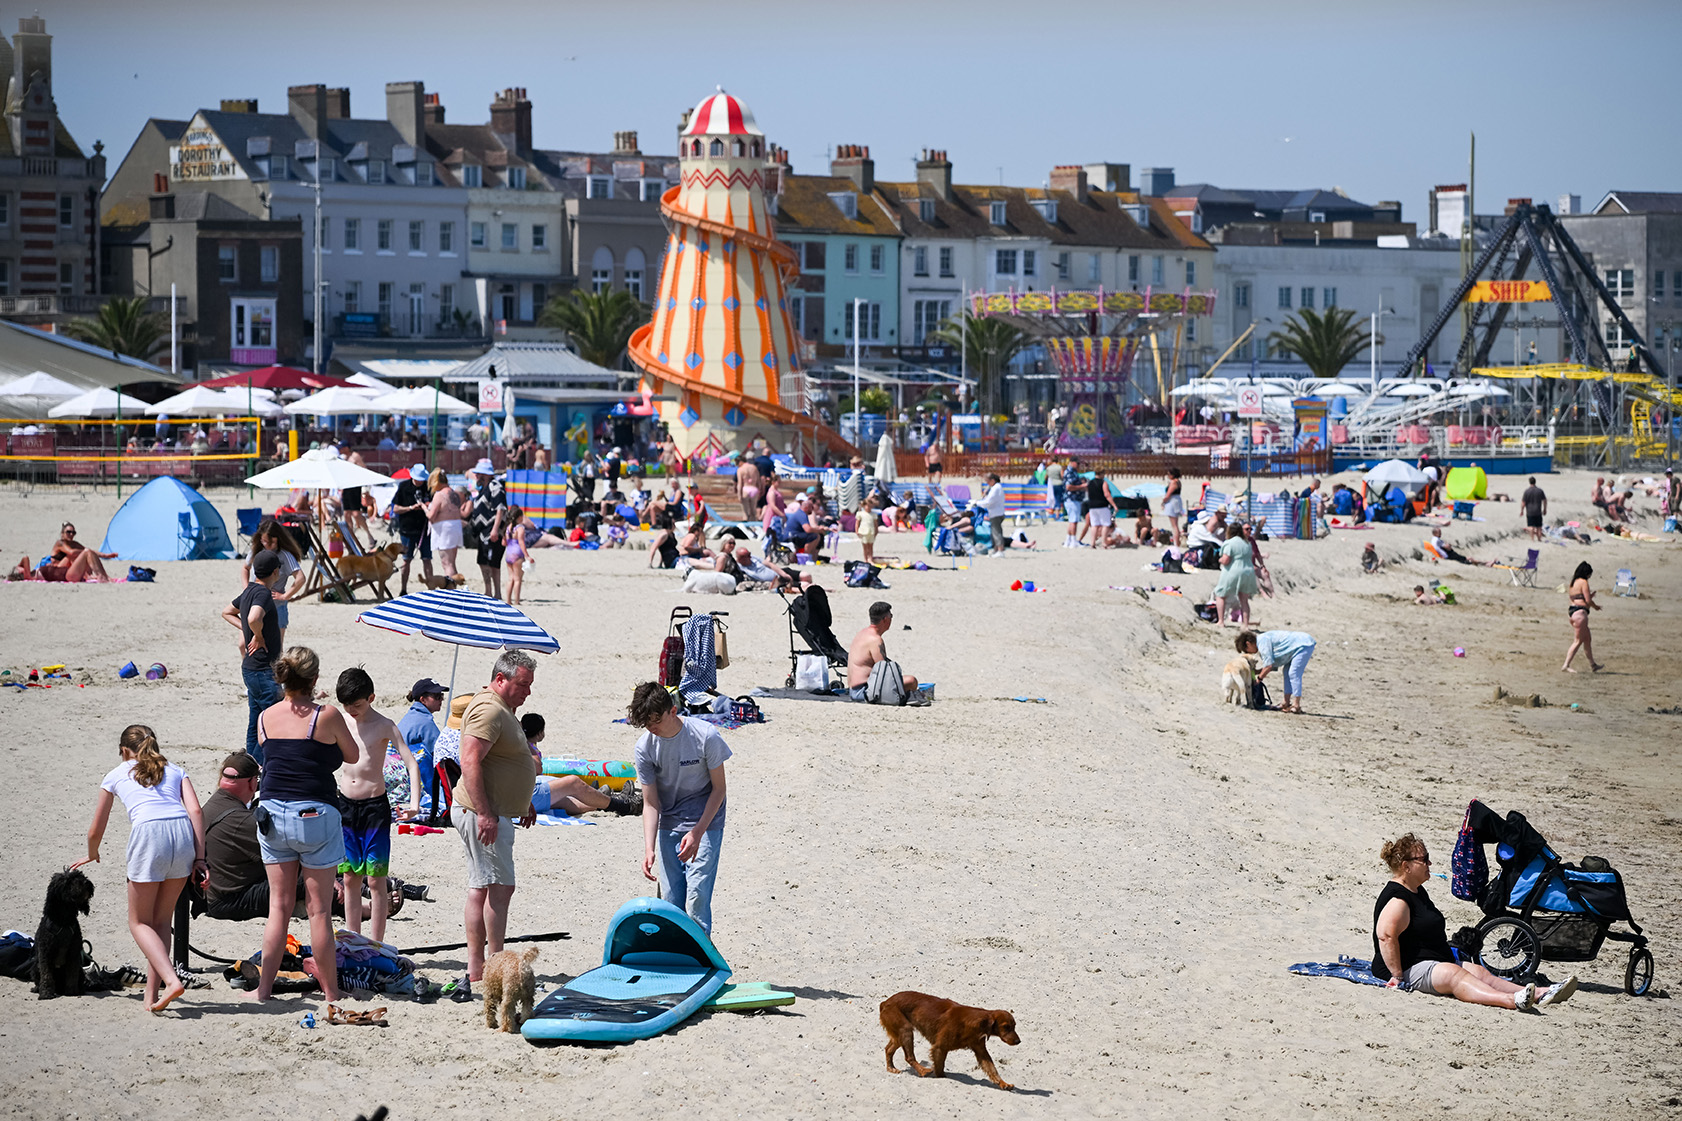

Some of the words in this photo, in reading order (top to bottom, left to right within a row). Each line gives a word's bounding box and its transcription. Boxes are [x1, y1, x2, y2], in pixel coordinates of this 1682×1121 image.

[178, 148, 221, 162] DOROTHY
[173, 163, 236, 178] RESTAURANT
[1489, 281, 1530, 301] SHIP
